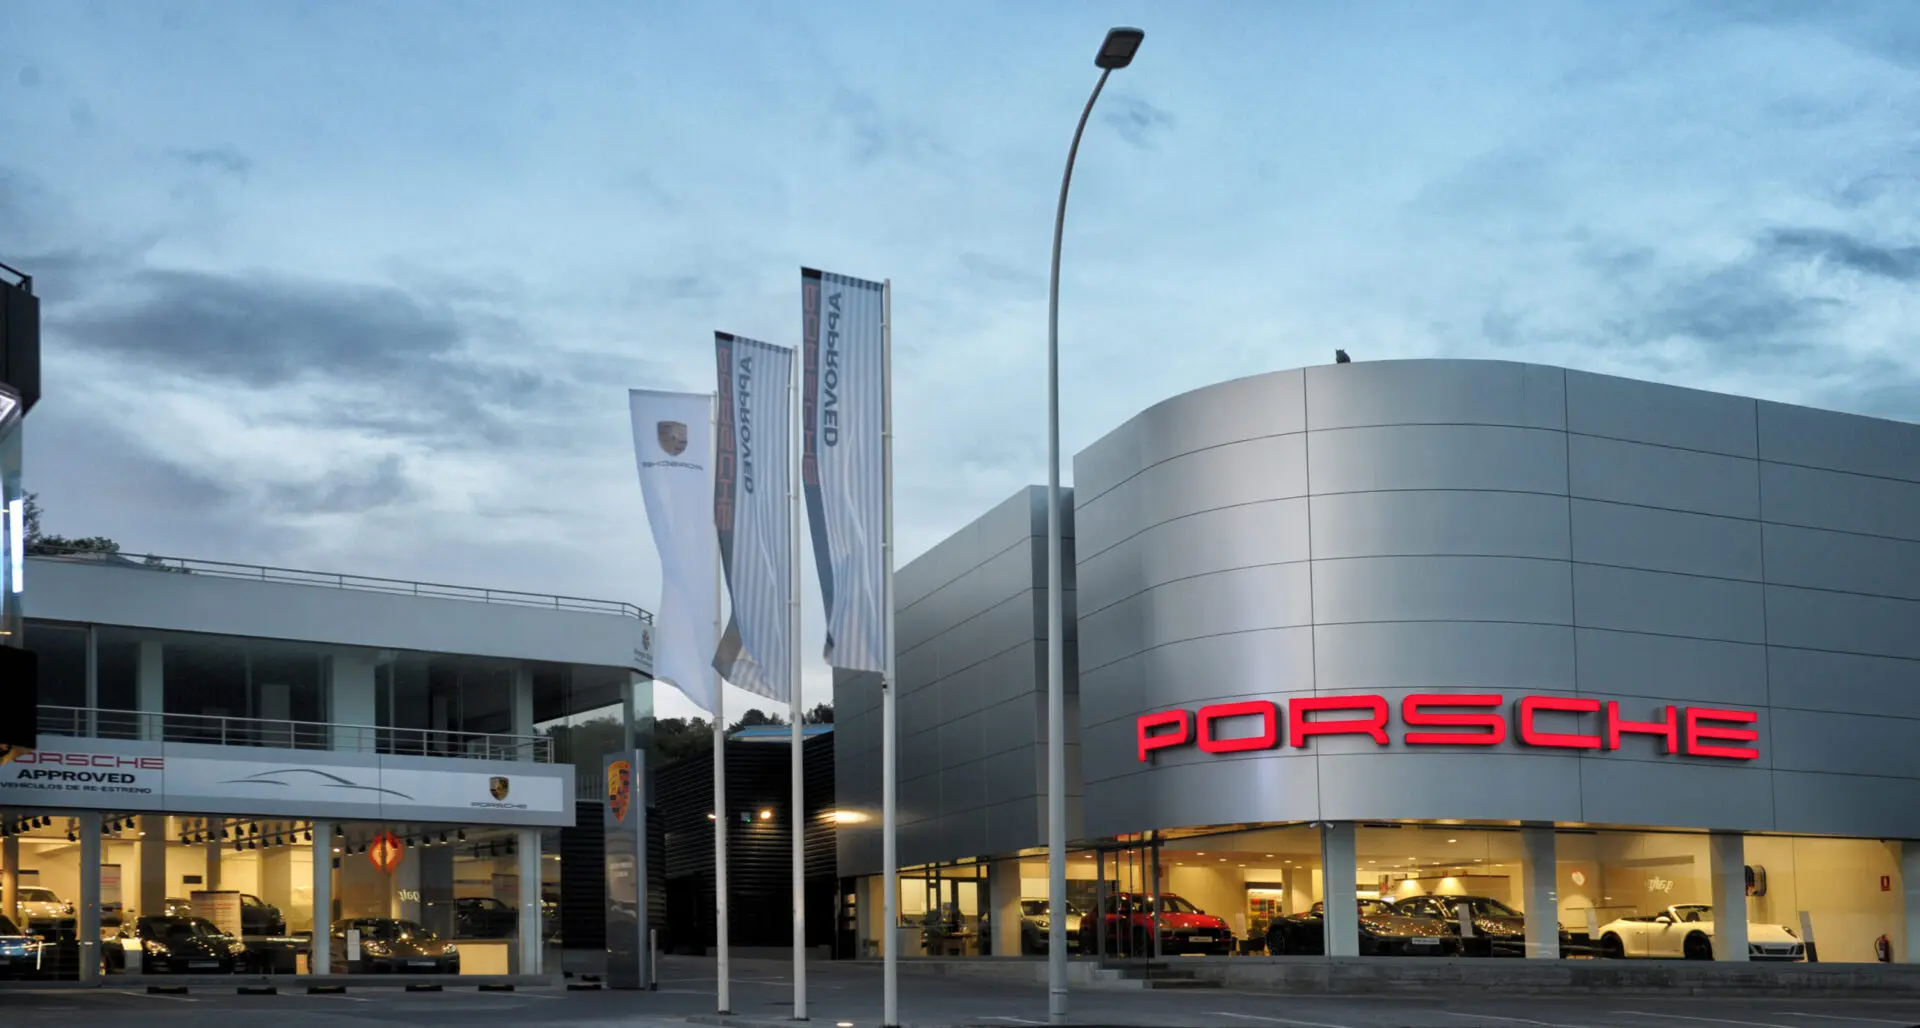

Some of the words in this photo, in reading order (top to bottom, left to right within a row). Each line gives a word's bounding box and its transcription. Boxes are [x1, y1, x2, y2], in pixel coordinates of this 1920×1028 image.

[1136, 693, 1760, 763] PORSCHE
[13, 752, 165, 770] ORSCHE
[17, 768, 136, 784] APPROVED
